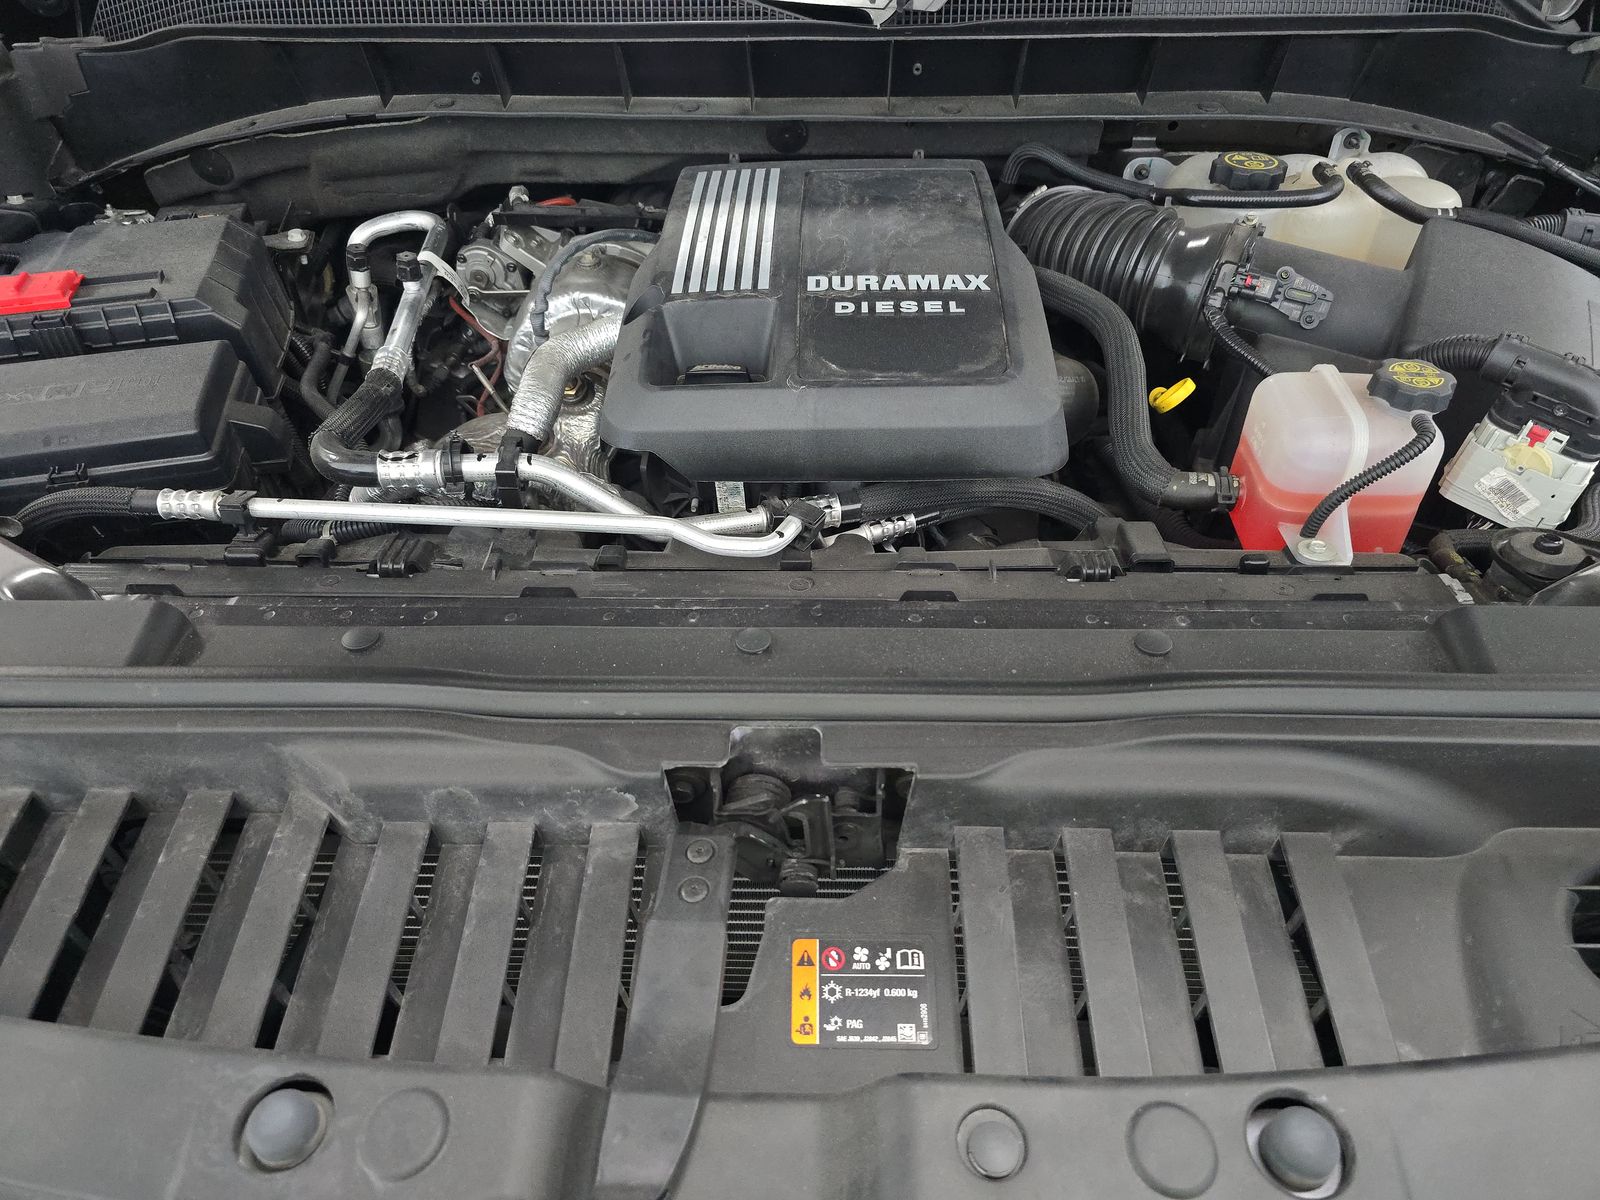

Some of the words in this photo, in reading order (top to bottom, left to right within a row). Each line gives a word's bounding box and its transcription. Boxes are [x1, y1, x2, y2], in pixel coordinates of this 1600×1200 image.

[806, 274, 991, 292] DURAMAX
[834, 301, 965, 315] DIESEL
[852, 962, 871, 970] AUTO
[845, 988, 880, 998] R-1234yf
[884, 988, 906, 997] 0.600
[907, 988, 918, 999] kg
[846, 1019, 863, 1029] PAG
